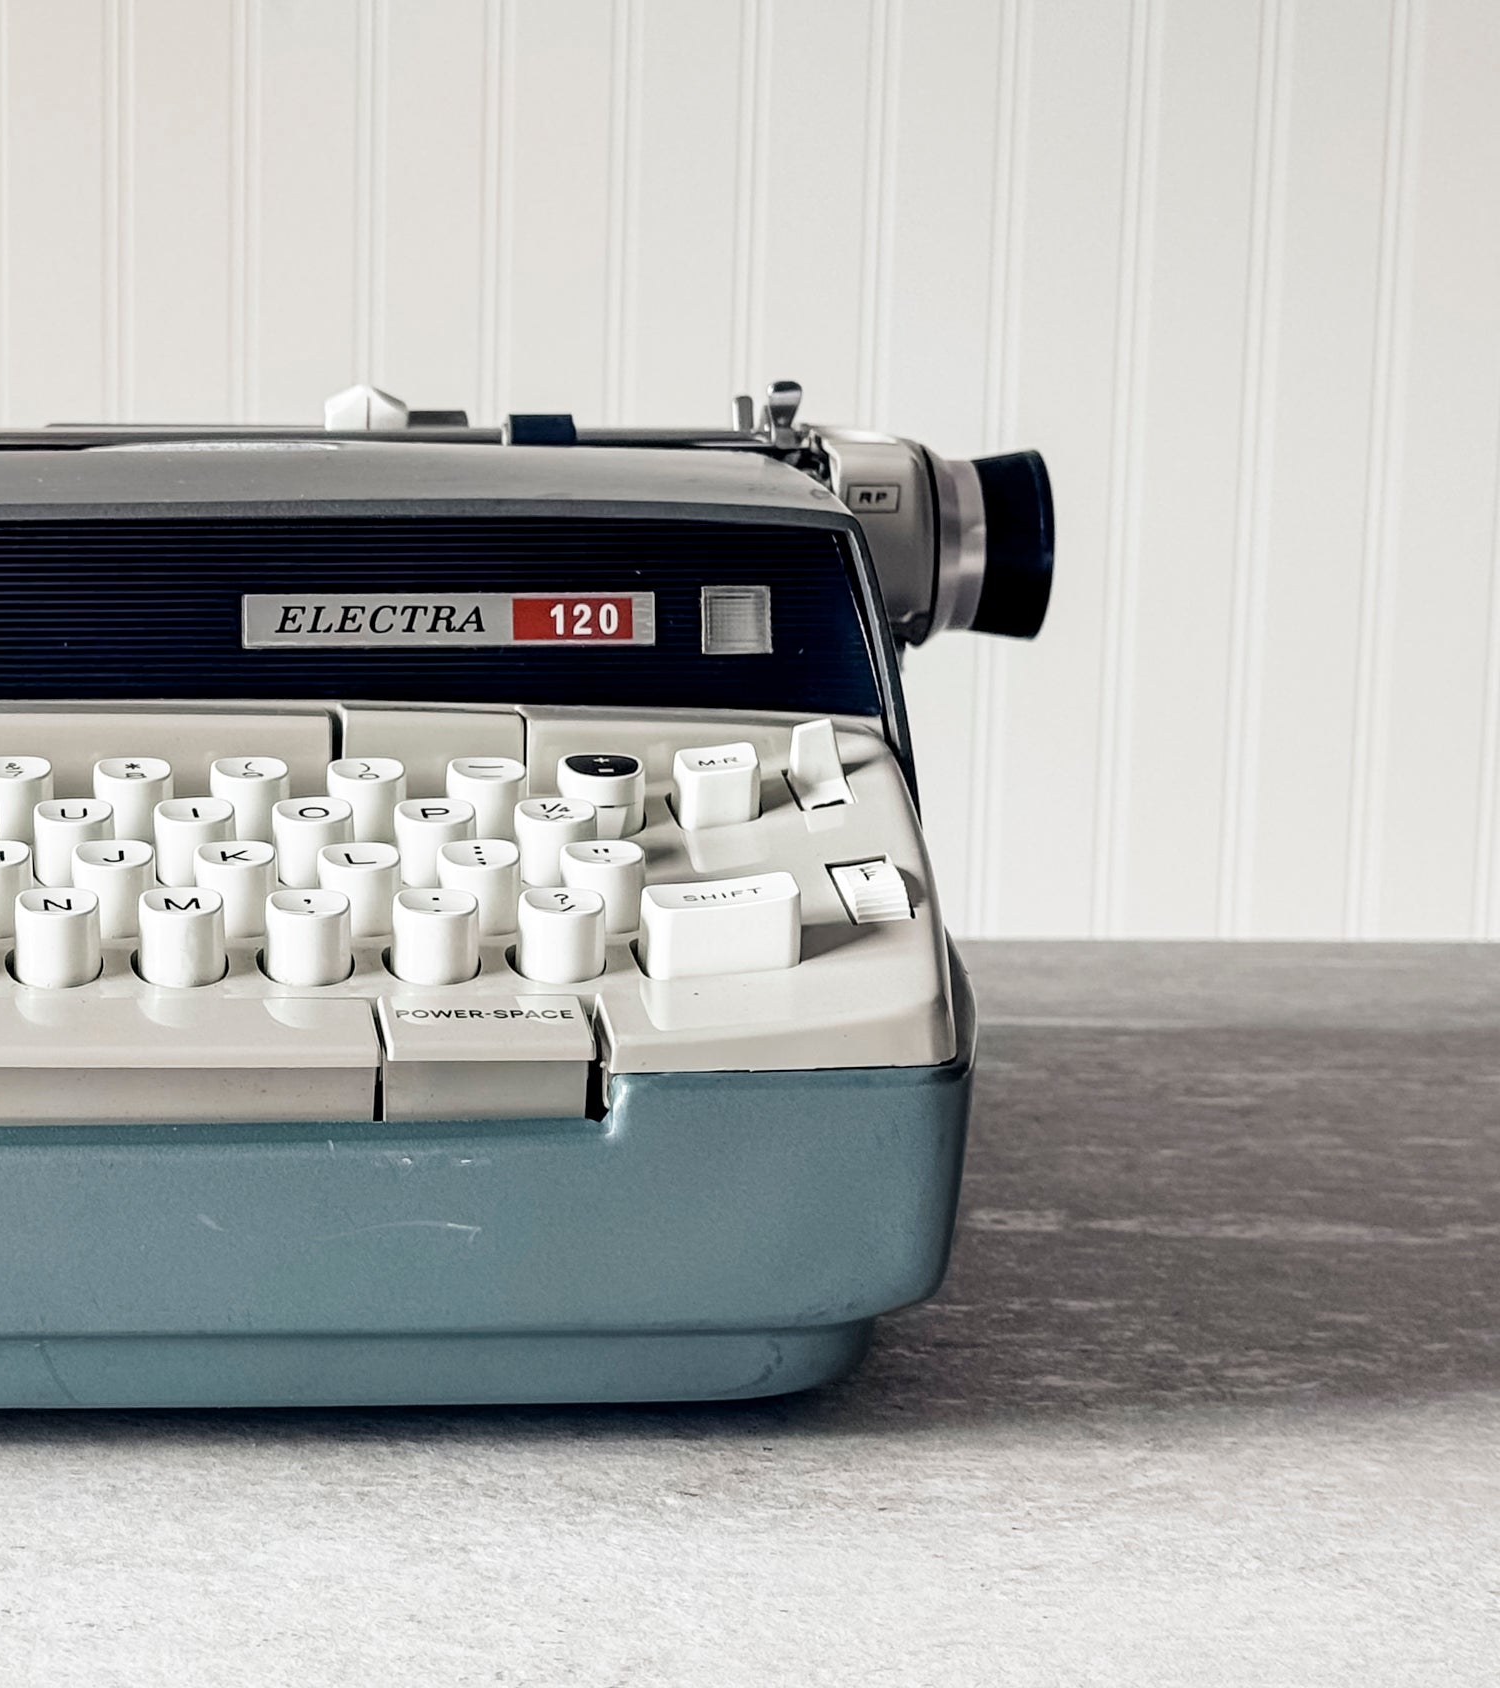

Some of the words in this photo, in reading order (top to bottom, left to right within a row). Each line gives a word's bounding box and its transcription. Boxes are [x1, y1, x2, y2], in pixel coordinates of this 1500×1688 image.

[859, 492, 887, 503] RP
[275, 605, 486, 633] ELECTRA
[550, 603, 619, 636] 120
[698, 756, 739, 767] M-R
[60, 807, 89, 820] U
[191, 807, 200, 819] I
[298, 806, 331, 819] O
[420, 806, 450, 819] P
[102, 850, 125, 863] J
[220, 849, 252, 862] K
[344, 853, 377, 865] L
[553, 892, 569, 905] ?
[682, 887, 761, 902] SHIFT
[43, 898, 73, 912] N
[162, 897, 202, 911] M
[395, 1009, 574, 1019] POWER-SPACE
